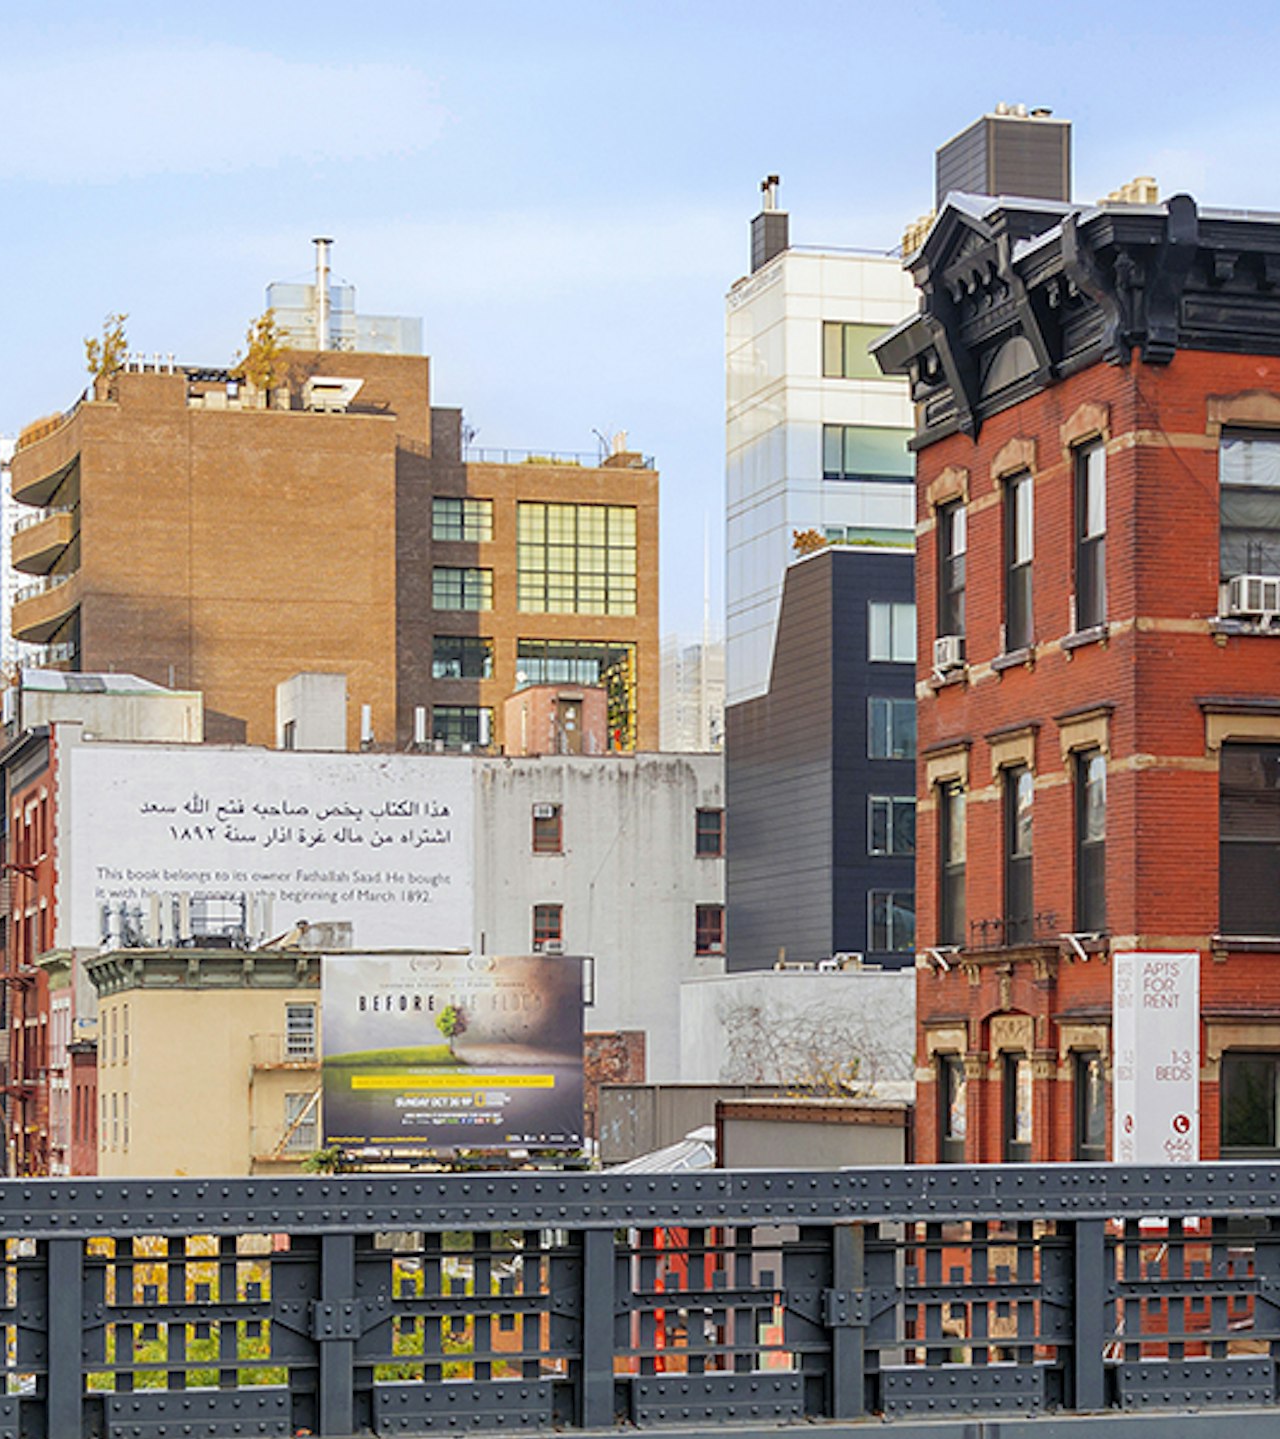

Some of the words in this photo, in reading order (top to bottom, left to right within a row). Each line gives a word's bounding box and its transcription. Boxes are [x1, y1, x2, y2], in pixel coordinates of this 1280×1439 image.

[140, 801, 176, 814] سعد
[183, 791, 210, 814] الله
[216, 800, 245, 821] فتح
[252, 800, 309, 819] صاحبه
[369, 800, 420, 822] الكتاب
[424, 800, 451, 817] هذا
[315, 801, 363, 822] يخص
[224, 825, 256, 842] سنة
[333, 827, 363, 843] ماله
[370, 831, 393, 848] من
[400, 829, 451, 848] اشتراه
[96, 866, 122, 880] This
[126, 868, 160, 881] book
[163, 869, 211, 884] belongs
[215, 870, 229, 881] to
[231, 869, 248, 881] its
[251, 872, 290, 882] owner
[296, 869, 350, 882] Fathallah
[385, 871, 405, 884] He
[407, 872, 452, 888] bought
[95, 886, 105, 898] it
[109, 886, 138, 898] with
[280, 889, 338, 904] beginning
[340, 889, 355, 901] of
[357, 889, 396, 902] March
[1143, 962, 1181, 977] APTS
[1143, 977, 1176, 992] FOR
[359, 995, 435, 1012] BEFORE
[1143, 994, 1180, 1008] RENT
[1172, 1050, 1192, 1064] 1-3
[1155, 1066, 1193, 1081] BEDS
[1163, 1138, 1193, 1152] 646
